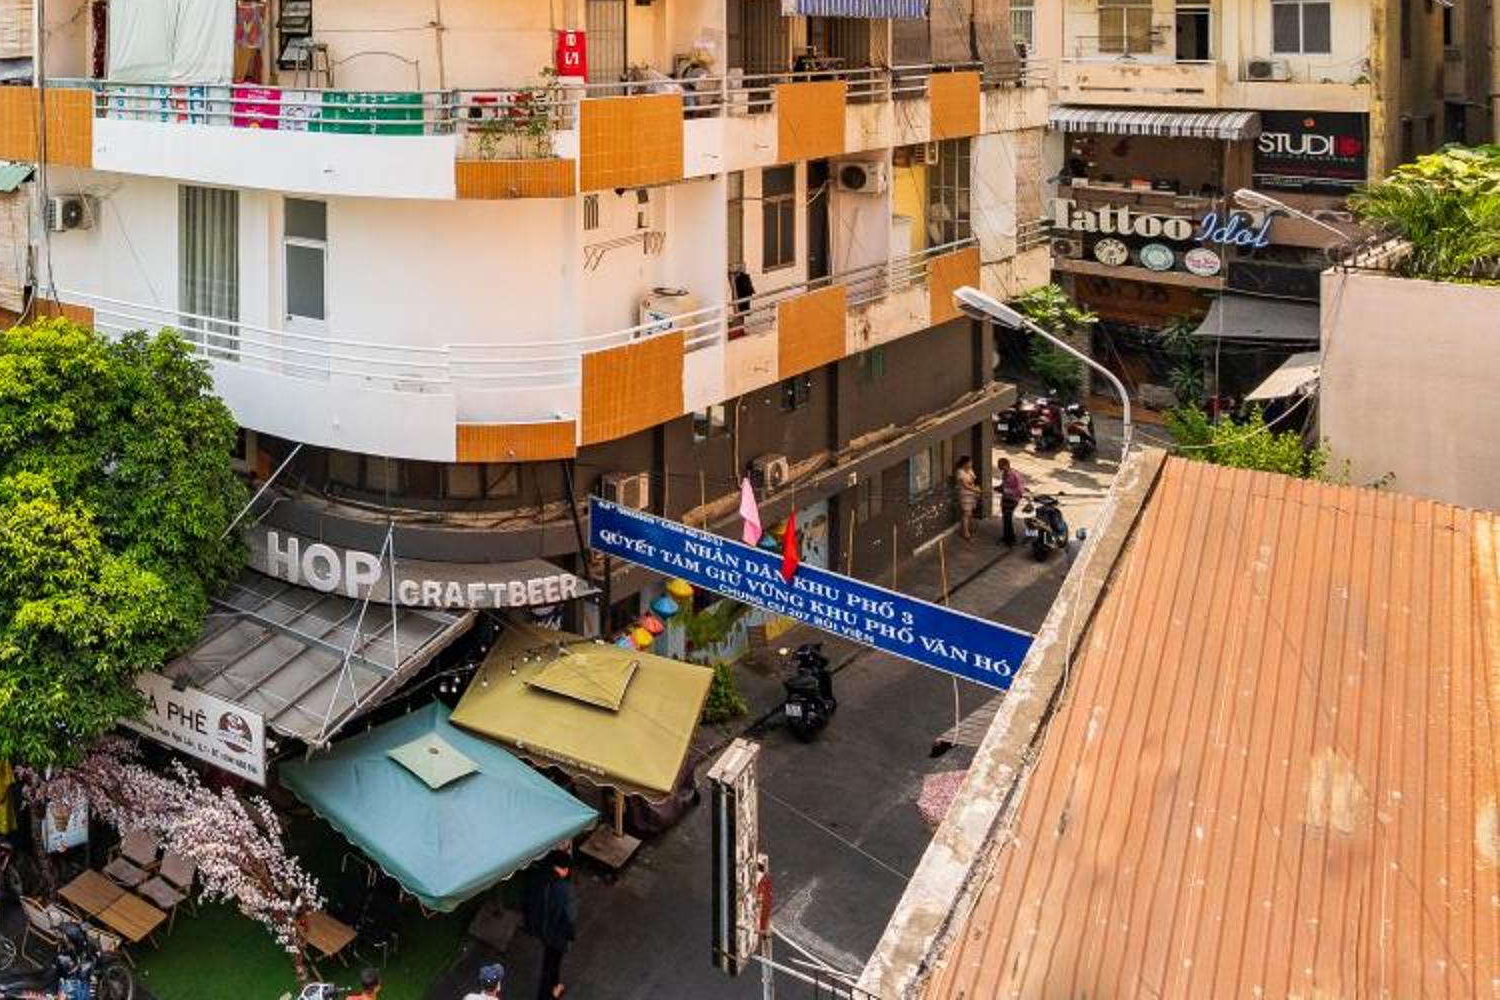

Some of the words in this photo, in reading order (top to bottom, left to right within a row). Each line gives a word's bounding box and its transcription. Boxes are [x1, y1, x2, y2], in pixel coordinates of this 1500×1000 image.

[1051, 197, 1193, 241] Tattoo
[1195, 212, 1271, 248] Idol
[267, 531, 383, 599] HOP
[684, 539, 740, 569] NHÂN
[793, 576, 840, 601] KHU
[847, 592, 895, 619] PHỐ
[901, 611, 915, 625] 3
[660, 548, 700, 573] TÂM
[810, 599, 858, 626] KHU
[864, 617, 915, 645] PHỐ
[974, 655, 1012, 678] HÓ
[167, 701, 208, 736] PHÊ
